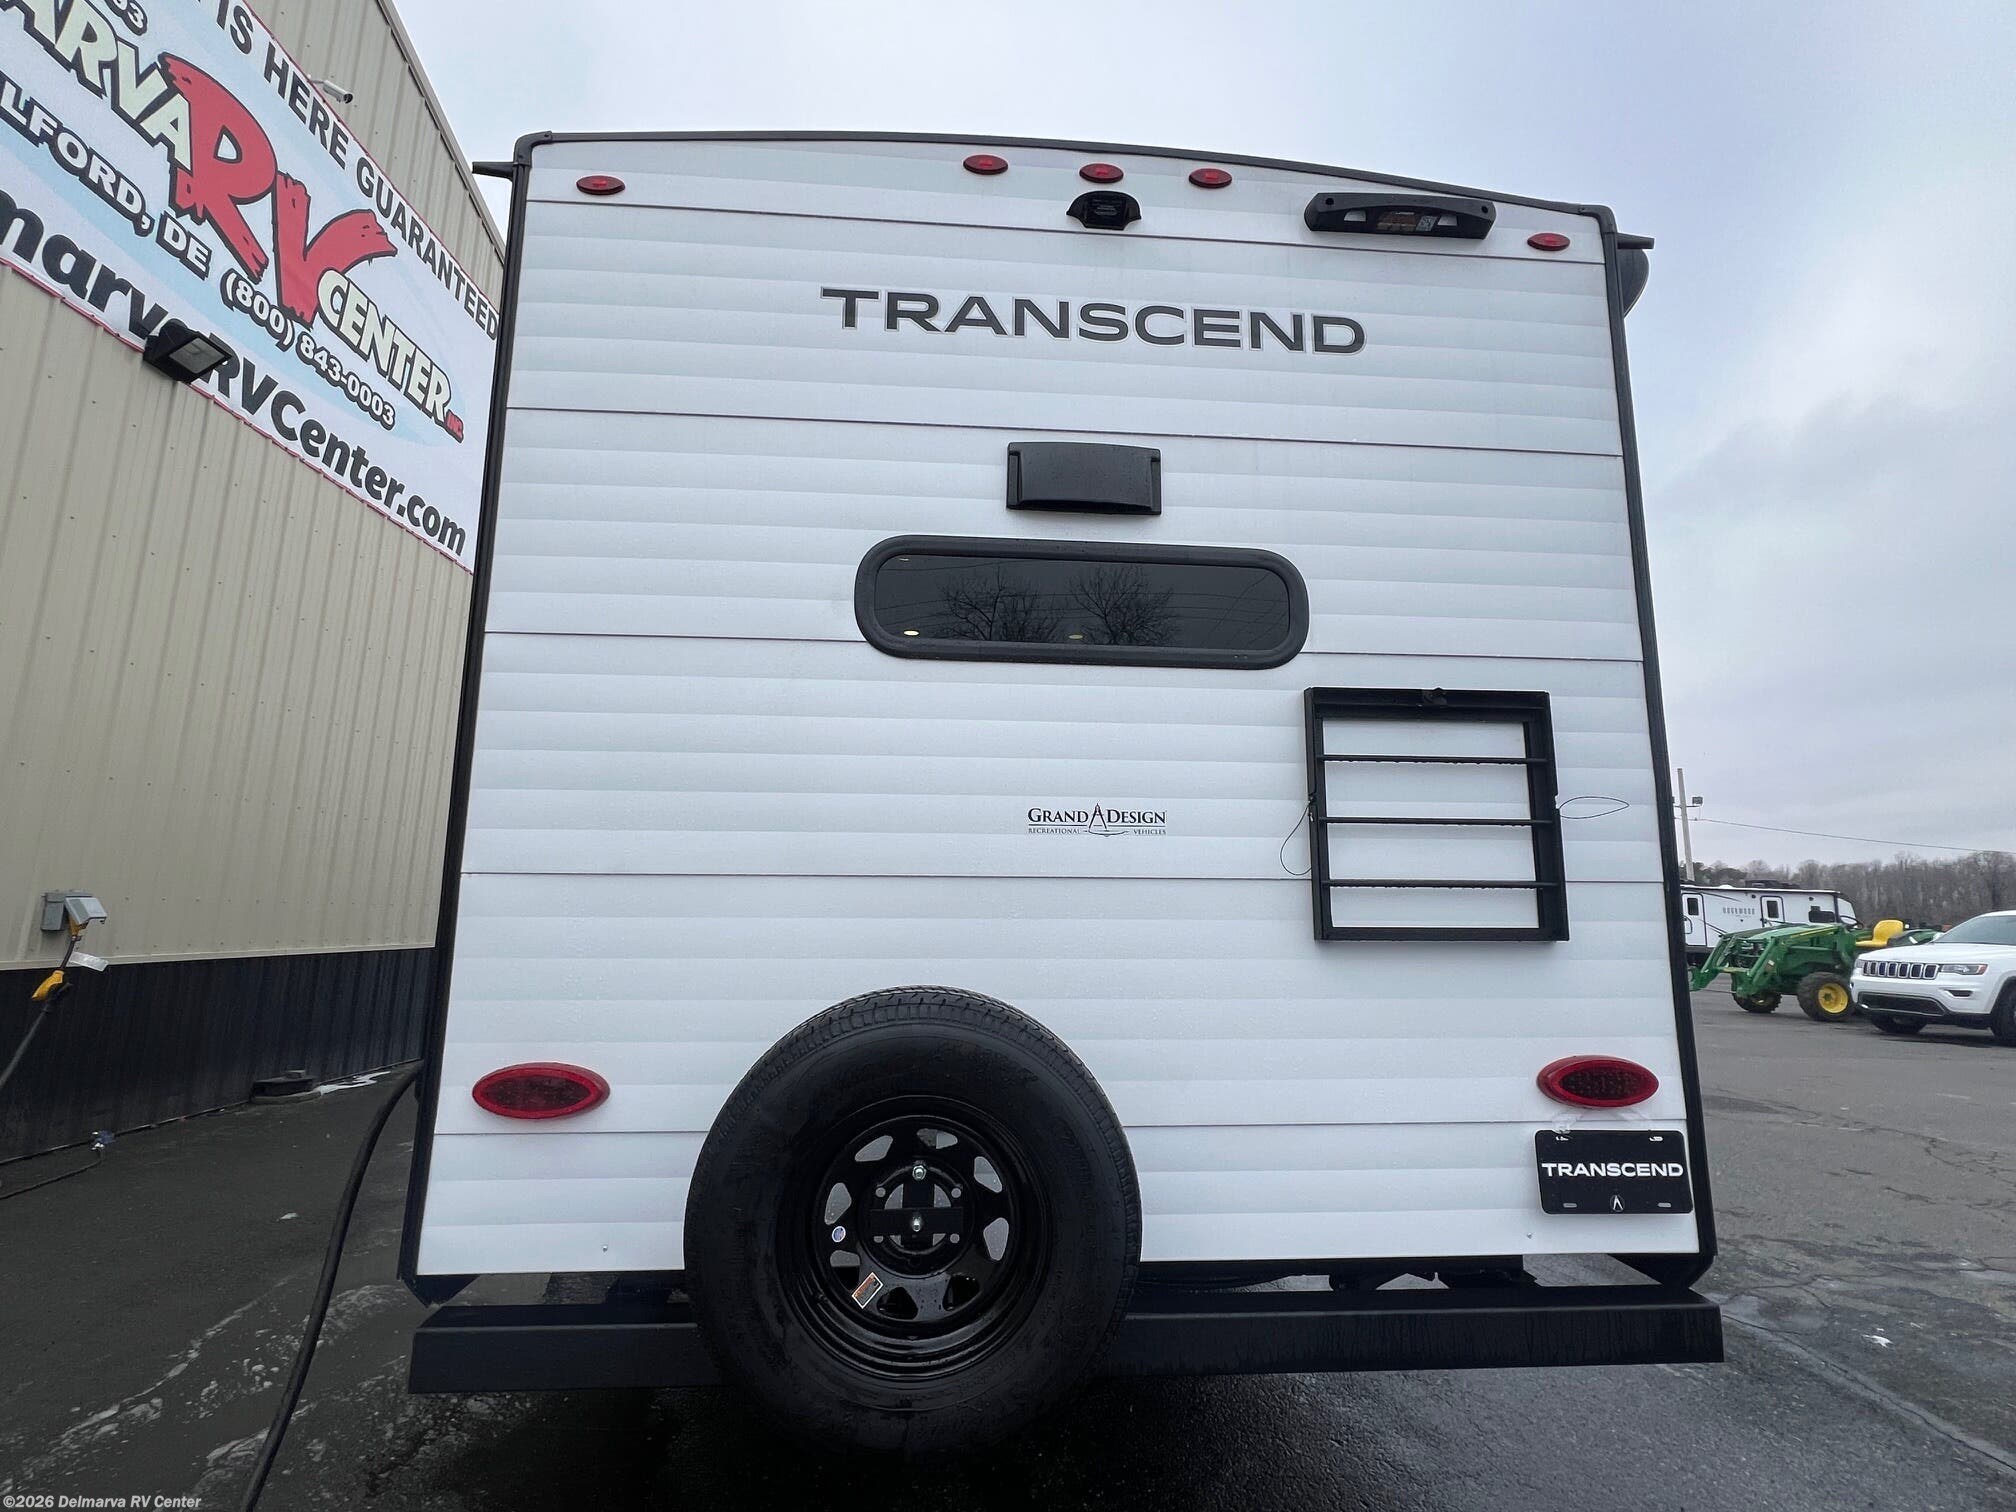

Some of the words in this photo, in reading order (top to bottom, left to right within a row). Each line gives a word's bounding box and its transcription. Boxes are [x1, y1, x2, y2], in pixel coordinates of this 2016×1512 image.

[264, 42, 349, 170] HERE
[357, 157, 499, 341] GUARANTEED
[158, 51, 398, 327] RV
[317, 268, 453, 427] CENTER
[159, 213, 211, 279] DE
[222, 270, 294, 349] (800)
[298, 333, 395, 429] 843-0003
[820, 286, 1366, 354] TRANSCEND
[1027, 808, 1089, 823] GRAND
[1107, 808, 1167, 824] DESIGN
[1133, 828, 1167, 836] VEHICLES
[1541, 1162, 1684, 1178] TRANSCEND
